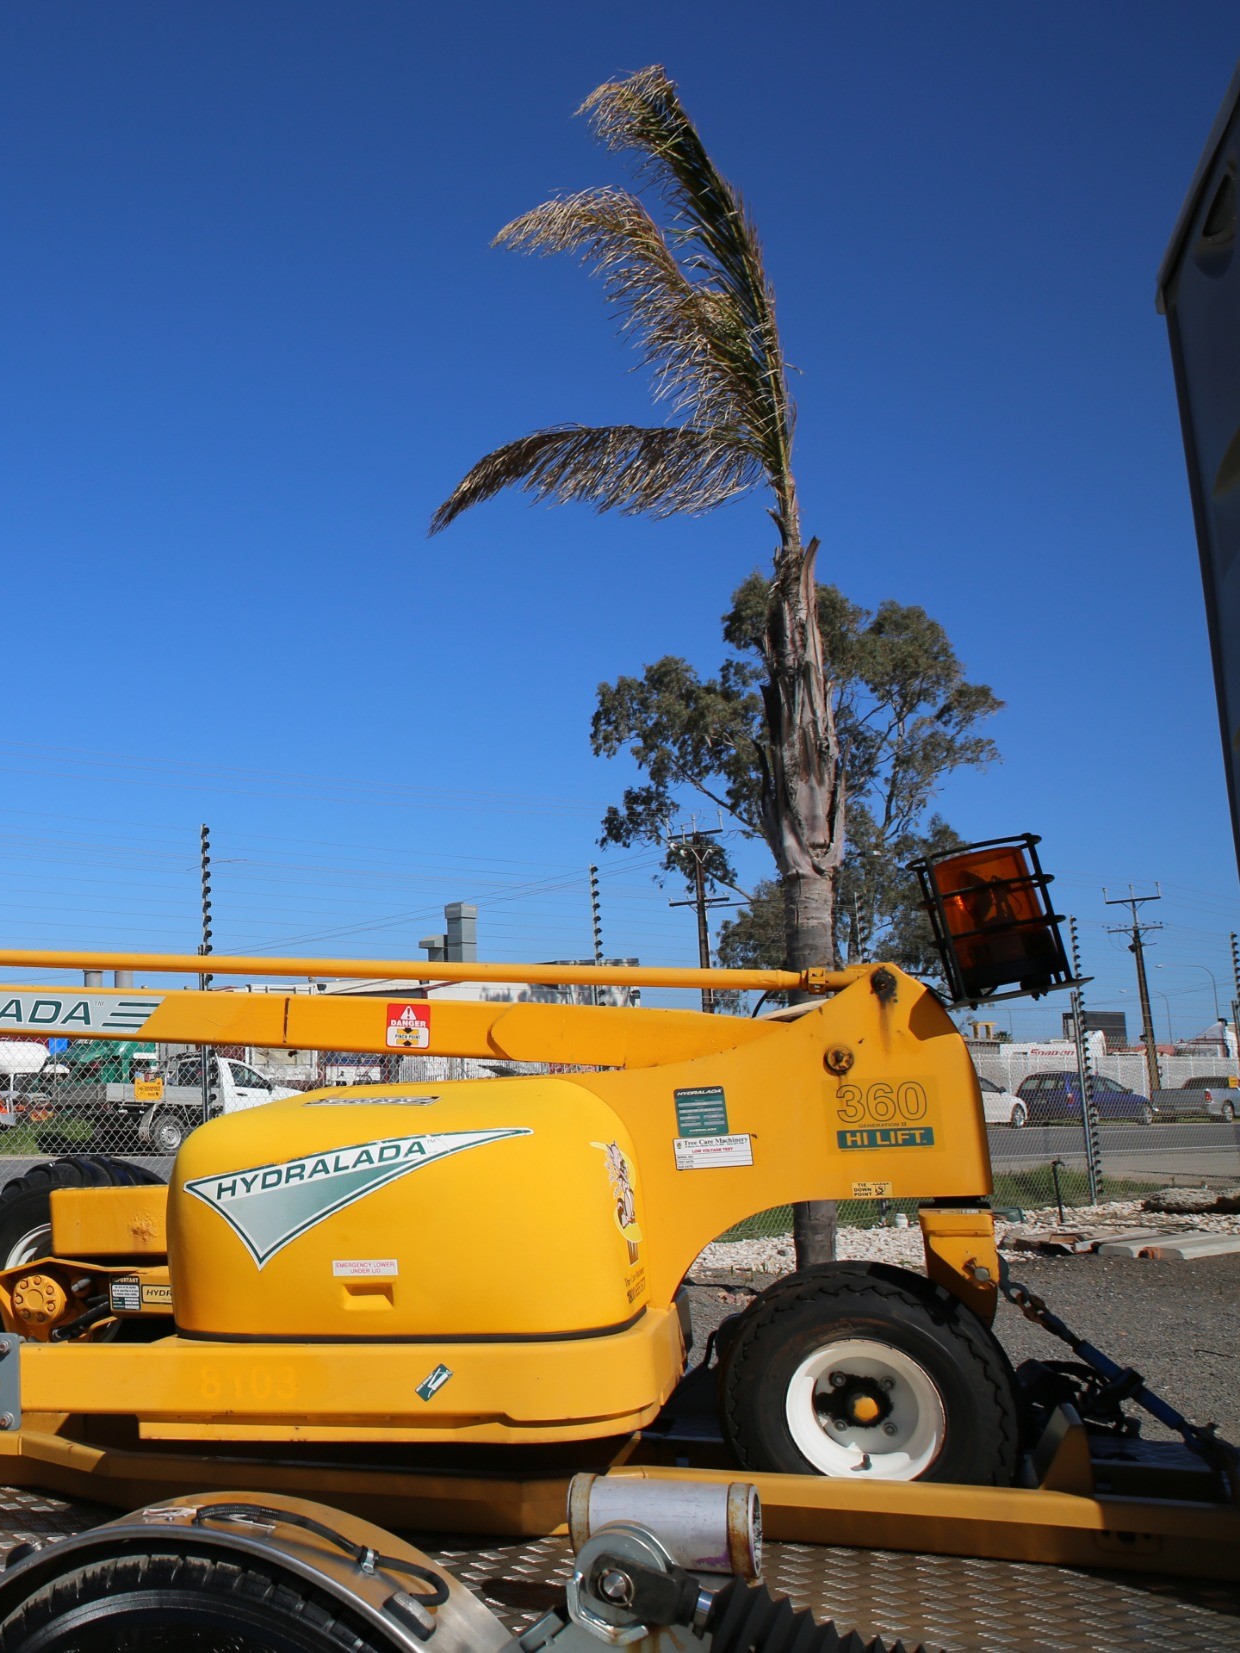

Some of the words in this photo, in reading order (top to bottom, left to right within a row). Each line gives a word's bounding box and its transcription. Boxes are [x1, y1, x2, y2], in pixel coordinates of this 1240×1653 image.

[677, 1088, 722, 1096] HYDRALADA
[835, 1081, 928, 1124] 360
[715, 1136, 748, 1144] Machinery
[845, 1131, 869, 1146] HI
[875, 1129, 925, 1145] LIFT
[215, 1140, 428, 1201] HYDRALADA
[200, 1365, 298, 1400] 8103
